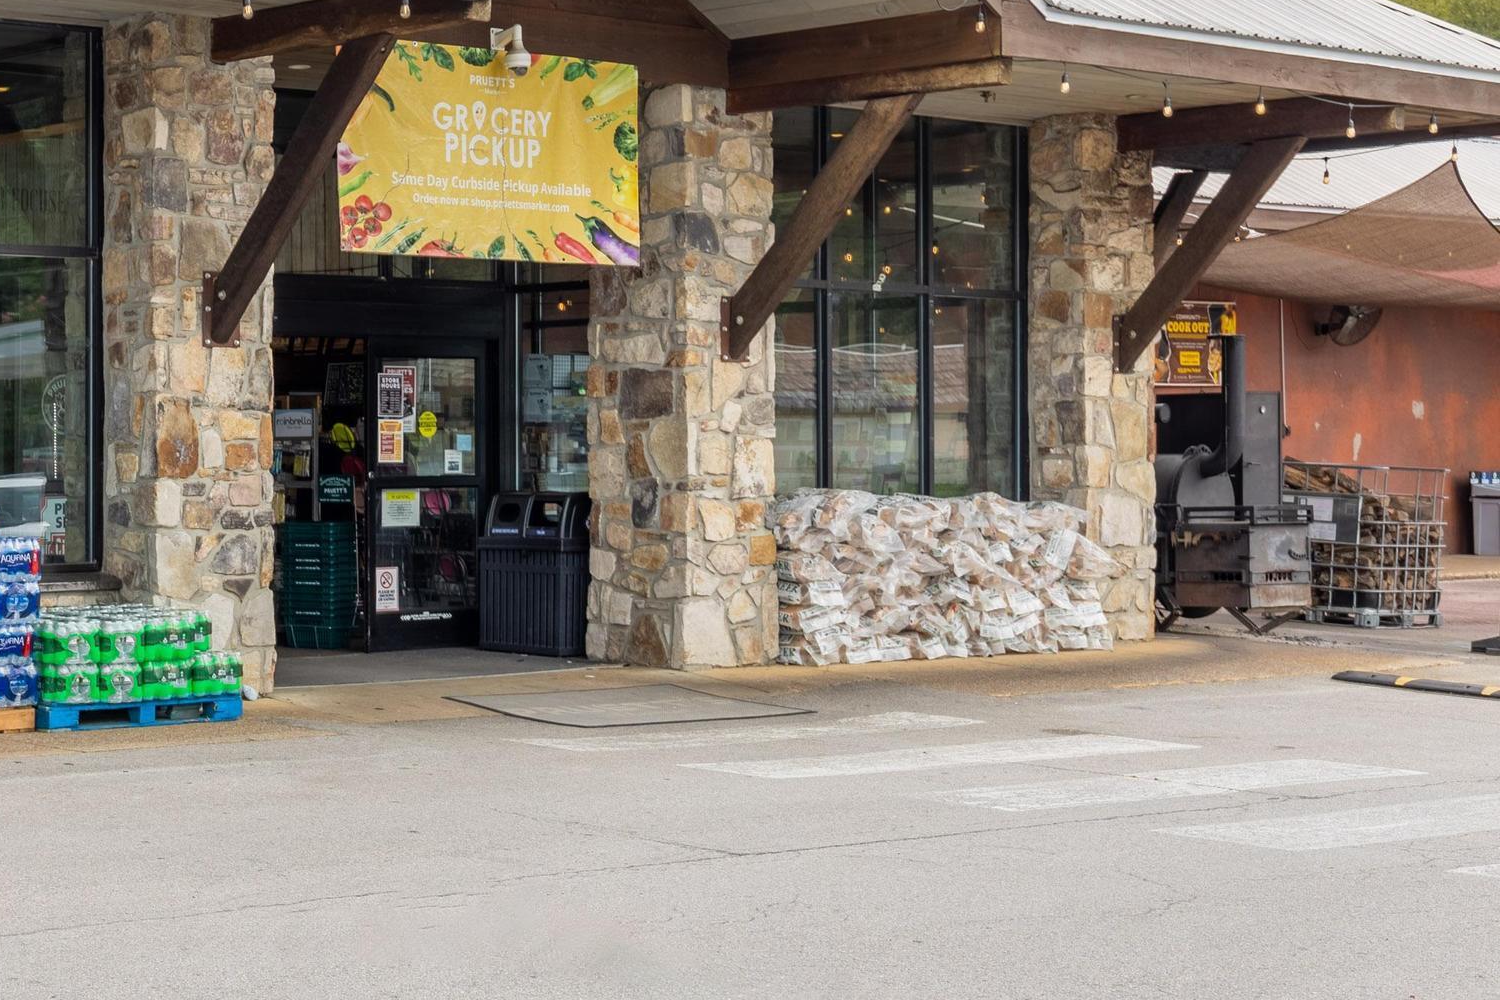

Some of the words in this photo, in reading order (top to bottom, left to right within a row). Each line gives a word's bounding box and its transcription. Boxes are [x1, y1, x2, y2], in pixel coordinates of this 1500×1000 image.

[432, 101, 552, 137] GROCERY
[444, 132, 541, 168] PICKUP
[391, 171, 424, 186] Same
[427, 174, 448, 191] Day
[451, 176, 500, 191] Curbside
[503, 179, 538, 197] Pickup
[540, 182, 592, 198] Available
